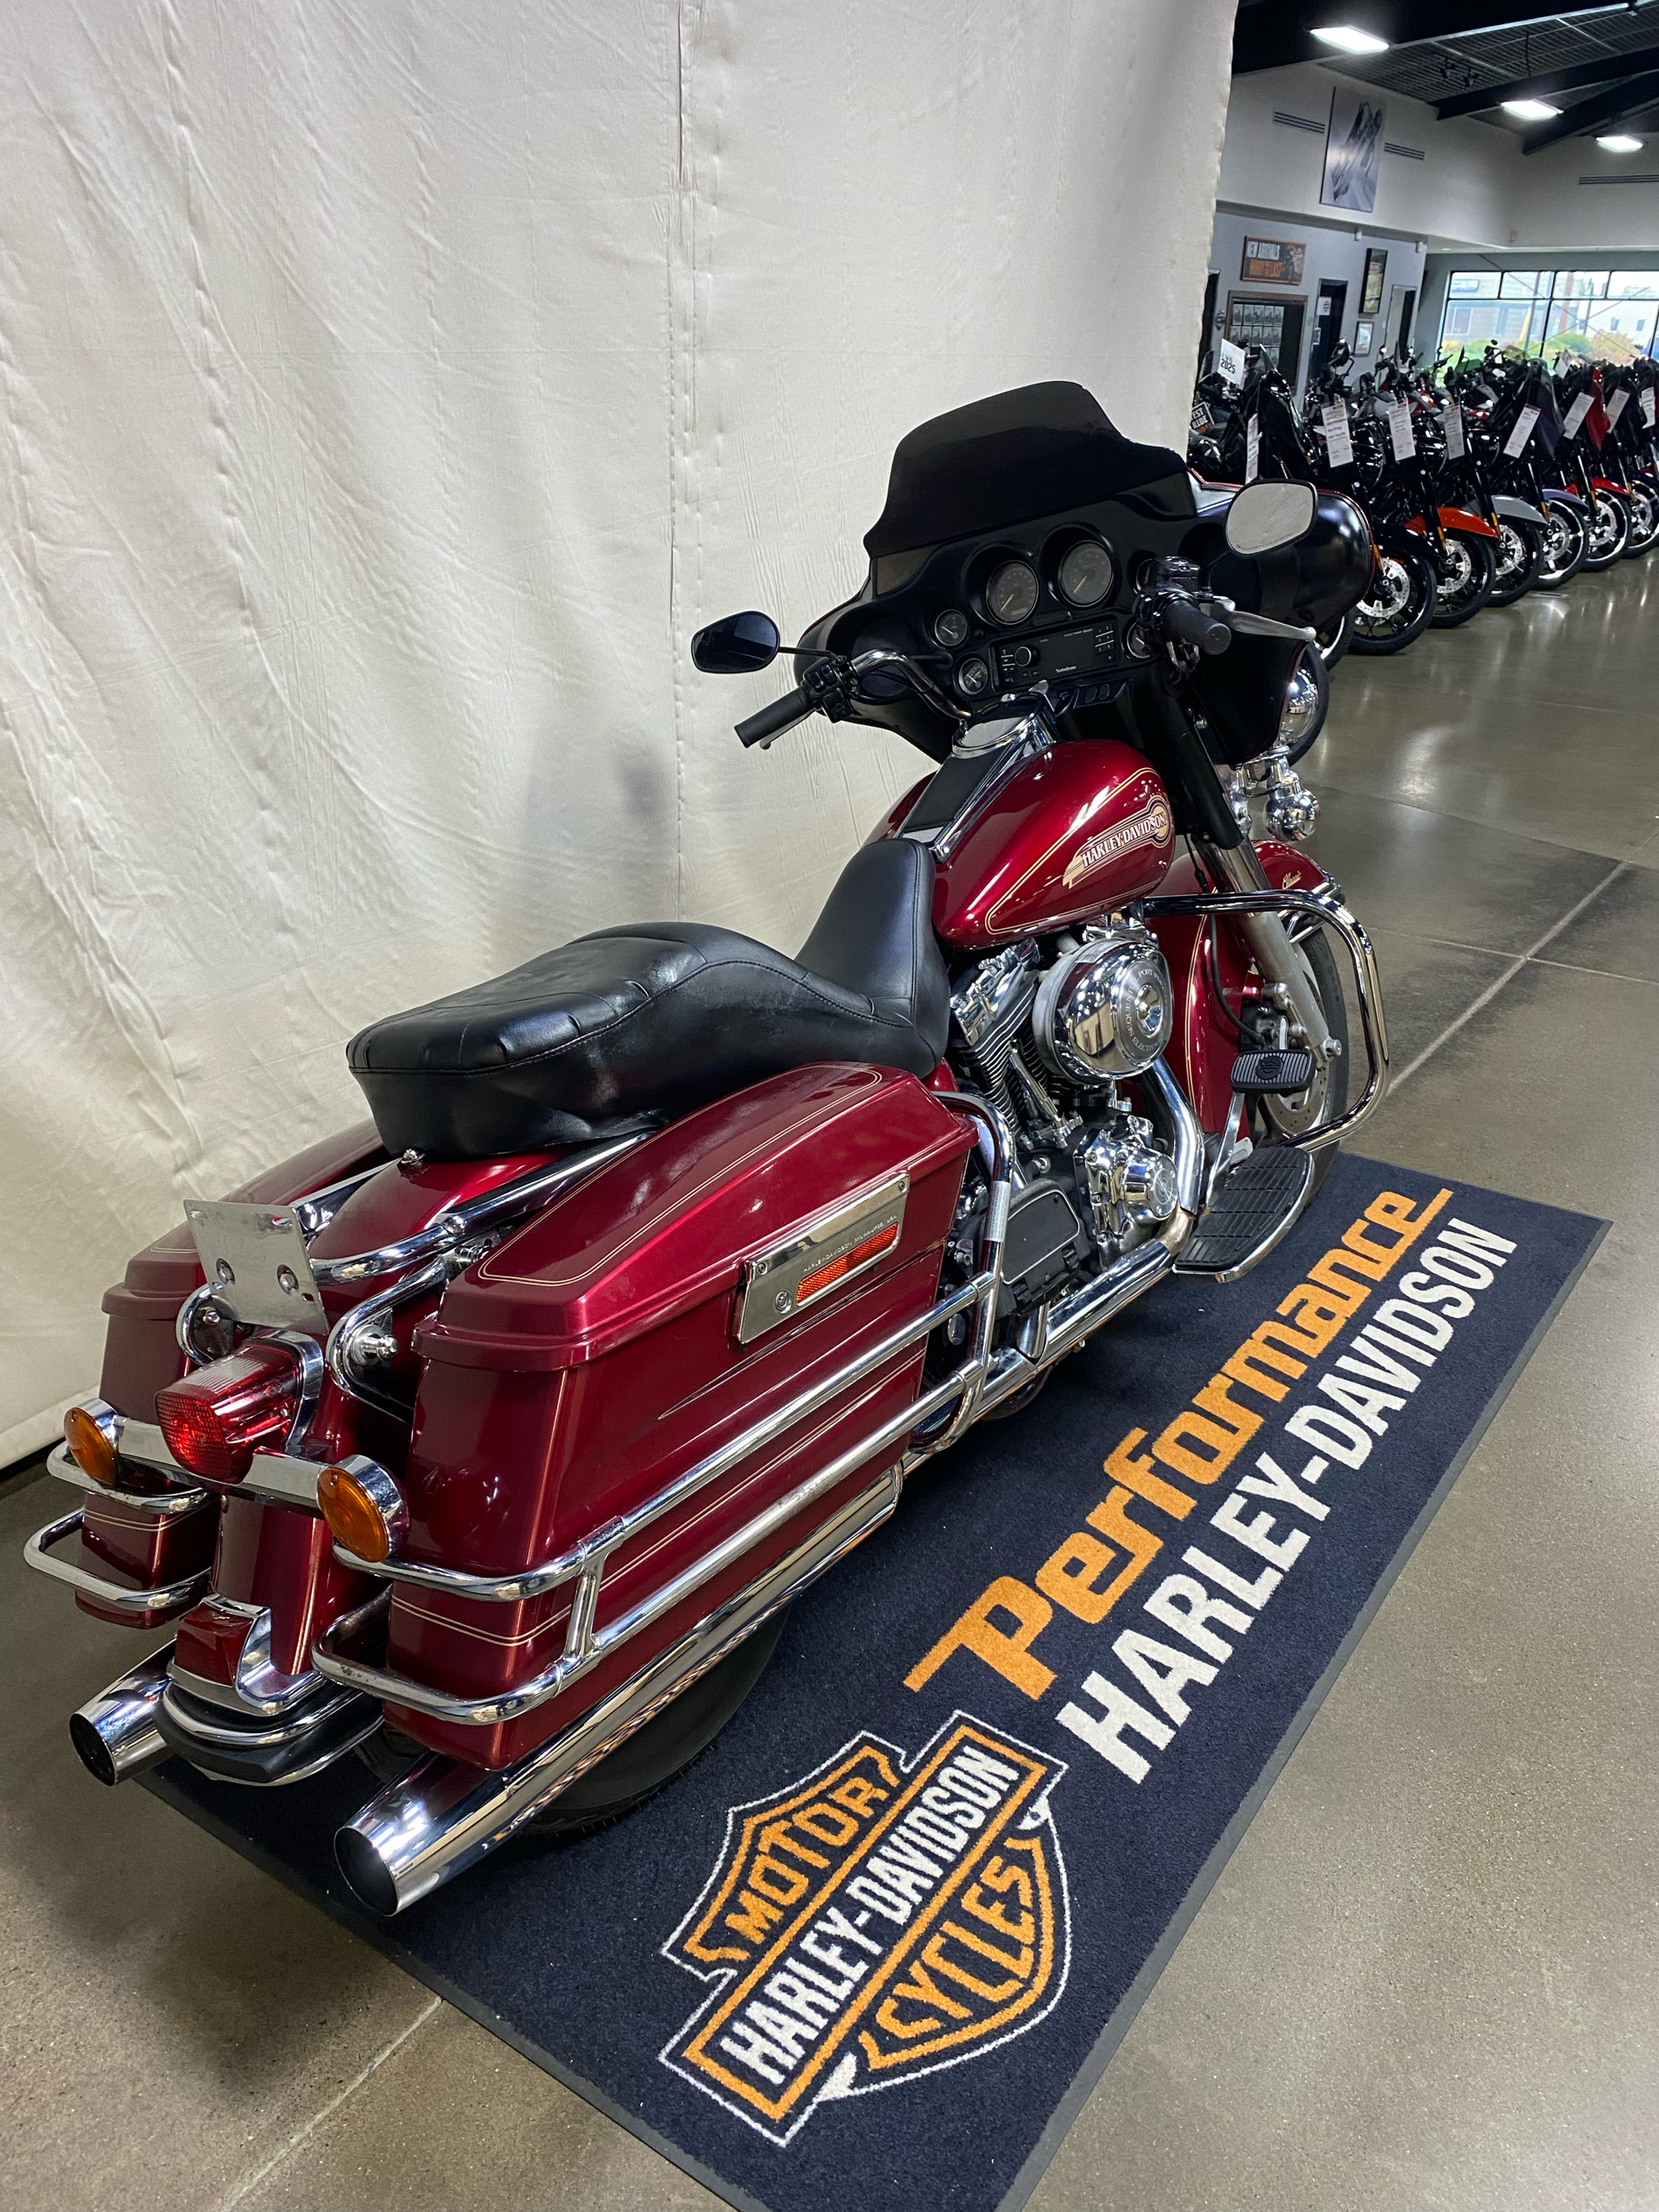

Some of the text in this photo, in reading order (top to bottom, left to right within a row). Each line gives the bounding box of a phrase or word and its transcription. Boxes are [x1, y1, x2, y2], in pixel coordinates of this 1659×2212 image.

[1192, 407, 1204, 420] EST
[1192, 416, 1209, 429] RIDE
[1220, 359, 1236, 374] 2025
[1138, 968, 1153, 978] PORT
[903, 1188, 1452, 1700] Performance
[1055, 1217, 1518, 1783] HARLEY-DAVIDSON
[720, 1745, 1020, 2085] HARLEY-DAVIDSON
[726, 1777, 890, 1945] MOTOR
[875, 1855, 1036, 2039] CYCLES
